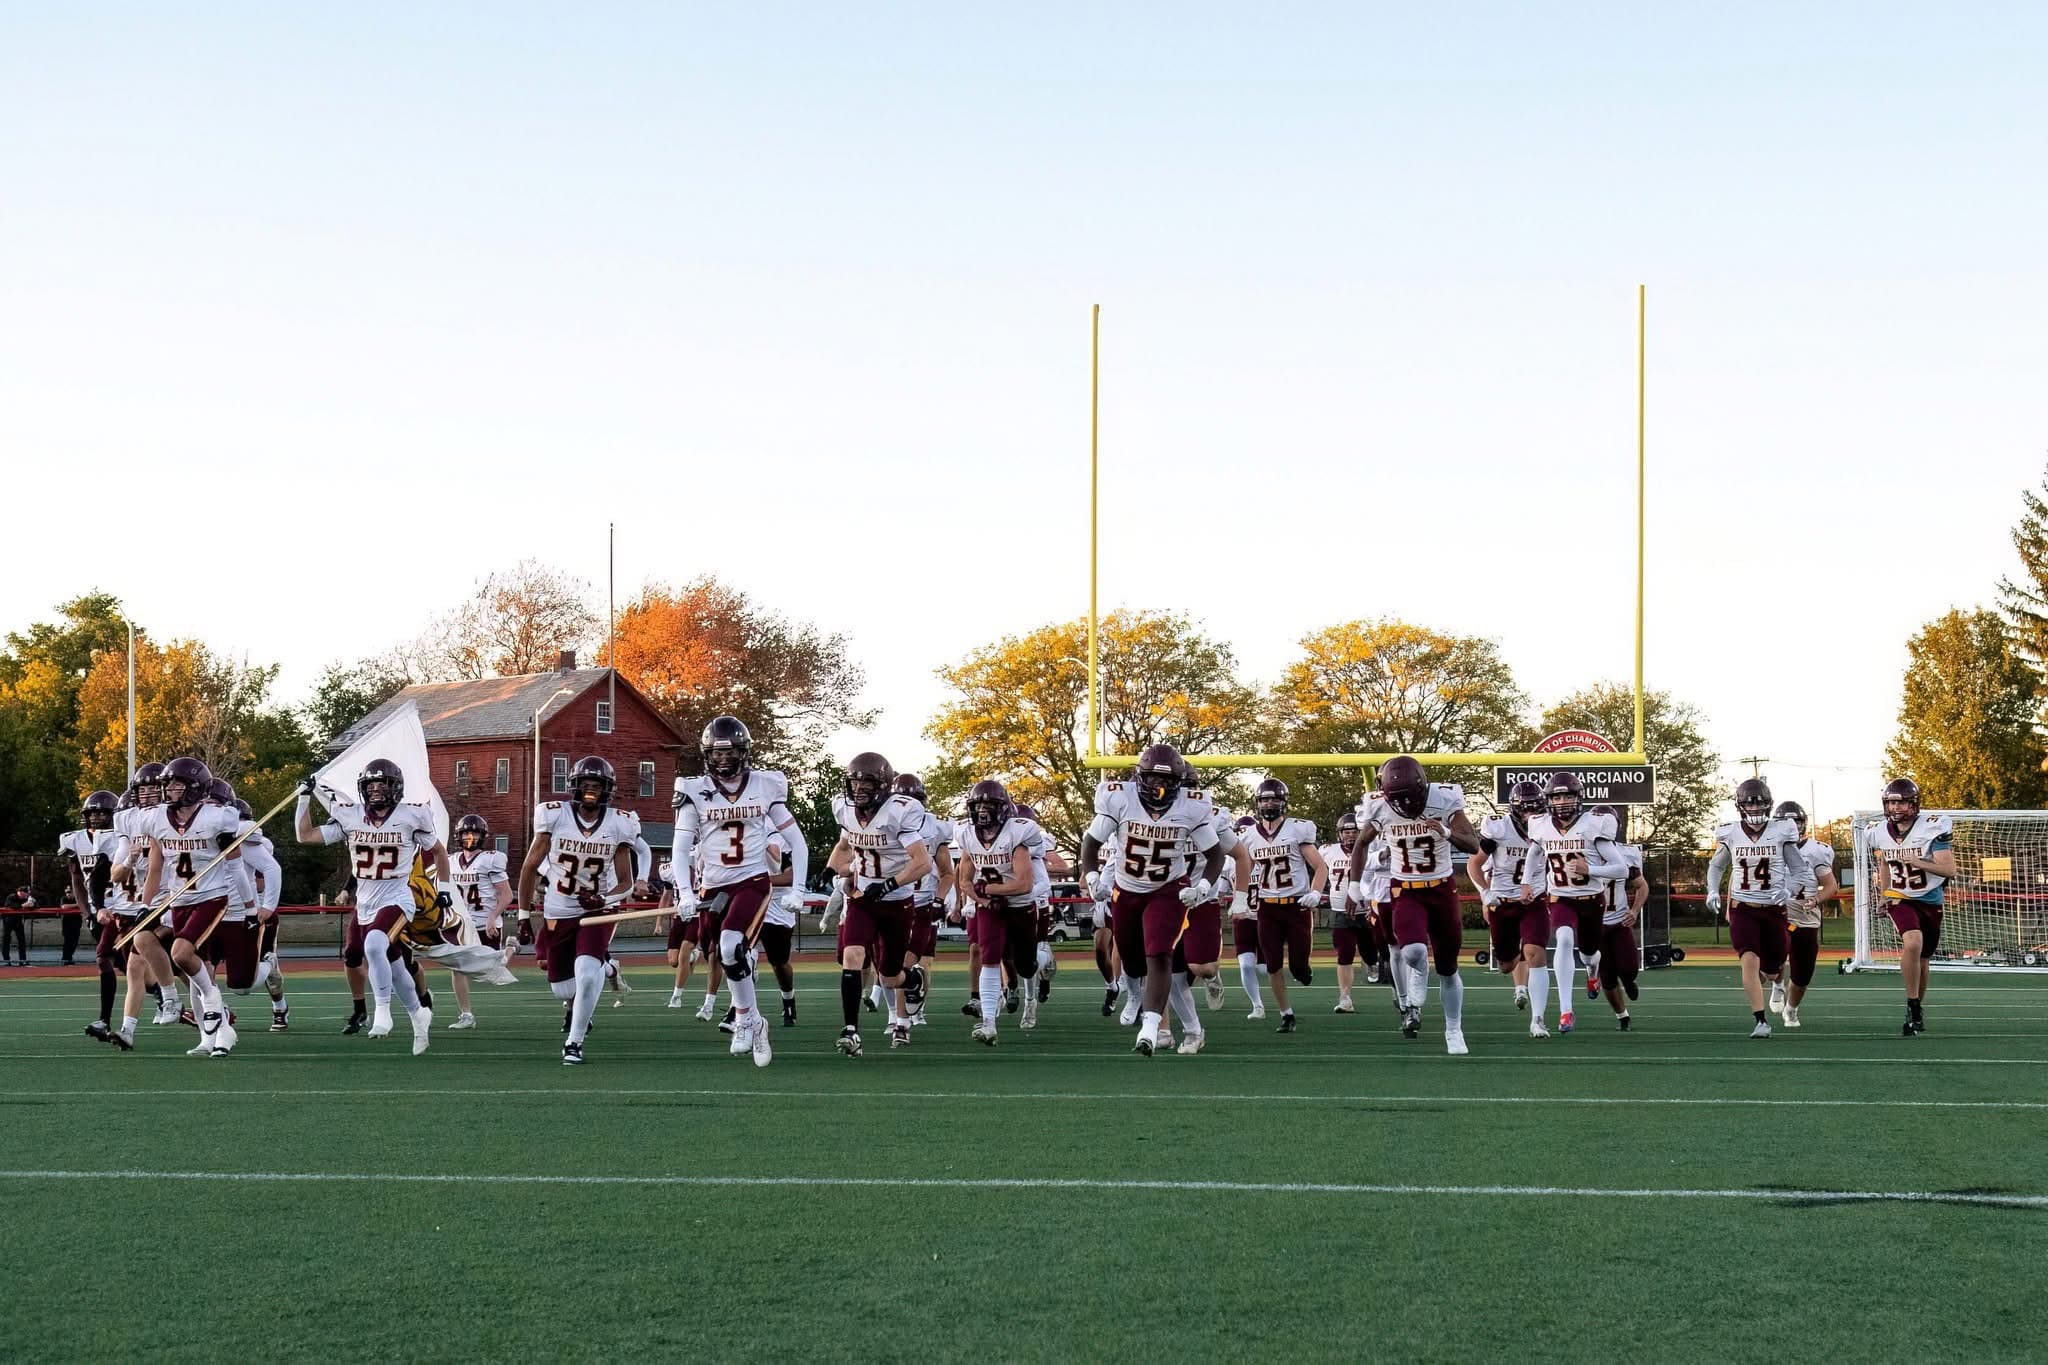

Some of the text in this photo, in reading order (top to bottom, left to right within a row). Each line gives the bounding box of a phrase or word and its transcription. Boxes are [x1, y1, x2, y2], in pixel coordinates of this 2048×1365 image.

[1552, 737, 1564, 747] OF
[1565, 735, 1610, 753] CHAMPIO
[1571, 771, 1645, 784] ARCIANO
[706, 805, 762, 821] WEYMOUTH
[849, 832, 888, 846] EYMOUTH
[1127, 821, 1180, 839] WEYMOUTH
[1391, 824, 1429, 836] WEYMOU
[560, 839, 612, 856] WEYMOUTH
[720, 821, 745, 866] 3
[1254, 844, 1291, 858] WEYMOUTH
[1396, 836, 1436, 874] 13
[1736, 845, 1777, 857] WEYMOUTH
[176, 852, 197, 890] 4
[356, 845, 400, 881] 22
[1125, 836, 1176, 882] 55
[557, 853, 605, 896] 33
[1260, 857, 1294, 890] 72
[1740, 858, 1771, 891] 14
[1887, 860, 1928, 891] 35
